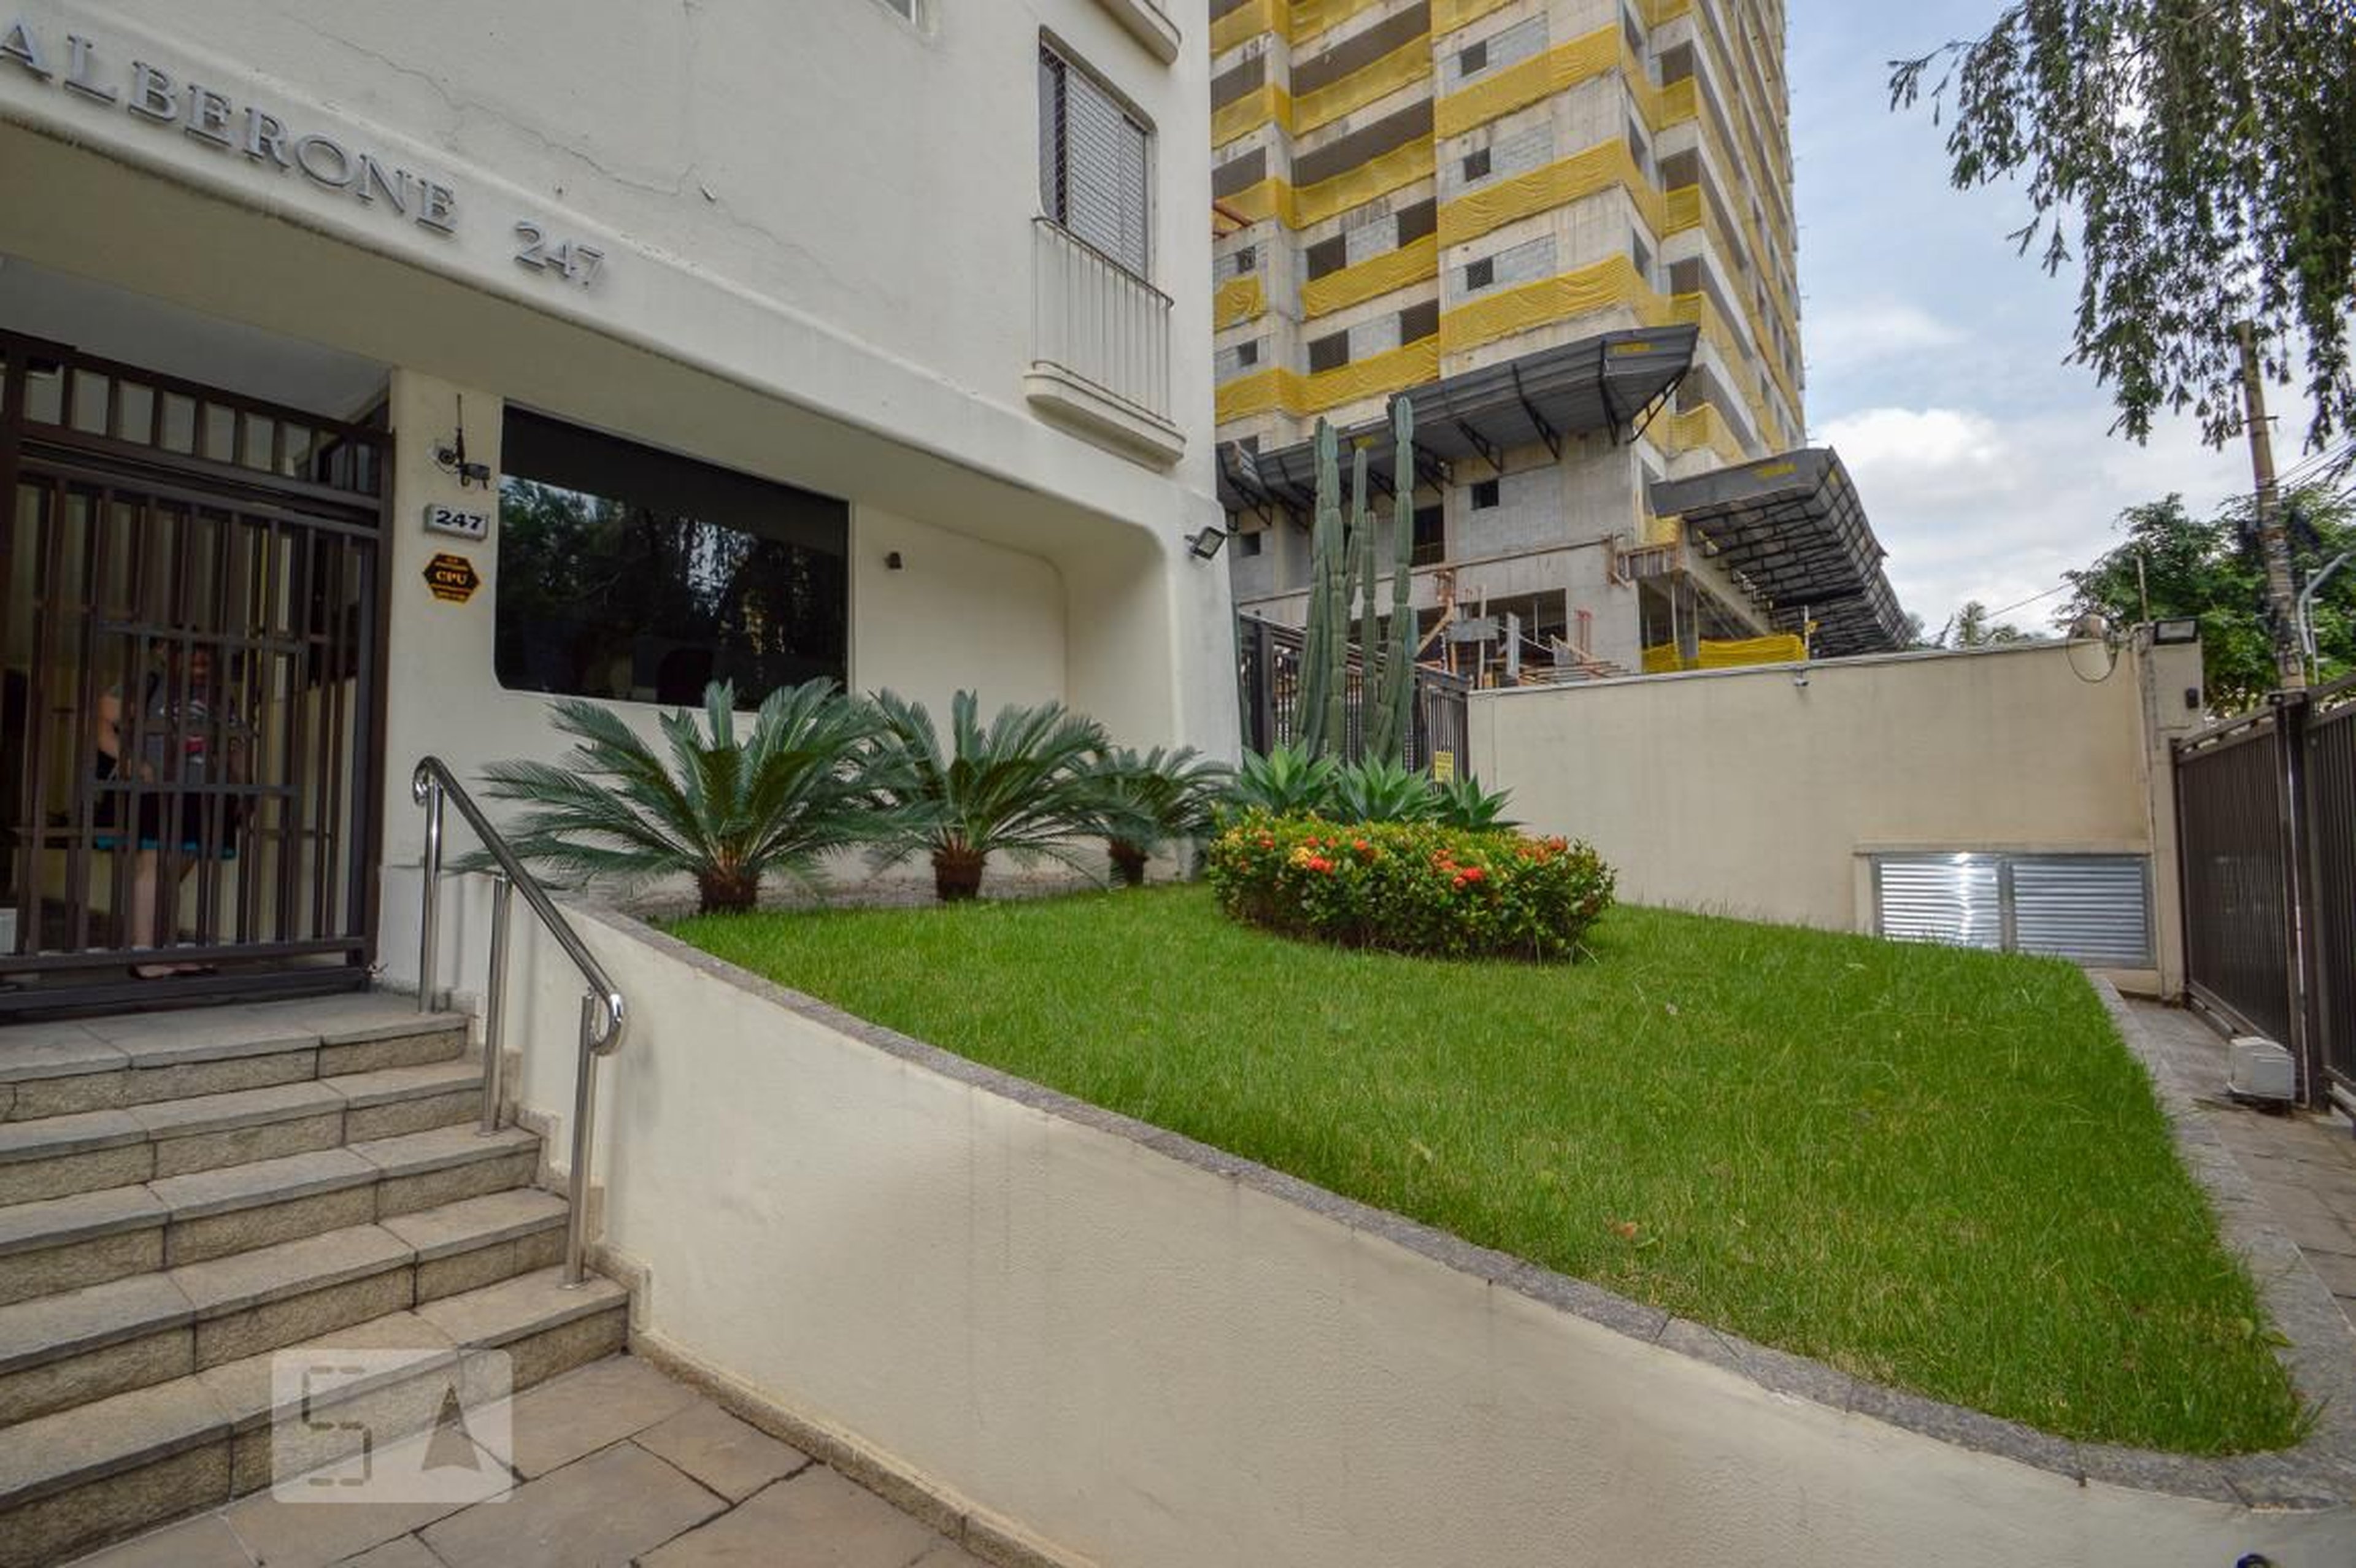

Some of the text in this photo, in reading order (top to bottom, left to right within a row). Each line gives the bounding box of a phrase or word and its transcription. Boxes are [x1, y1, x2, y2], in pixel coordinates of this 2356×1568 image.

[0, 16, 604, 287] ALBERONE 247
[436, 510, 482, 530] 247
